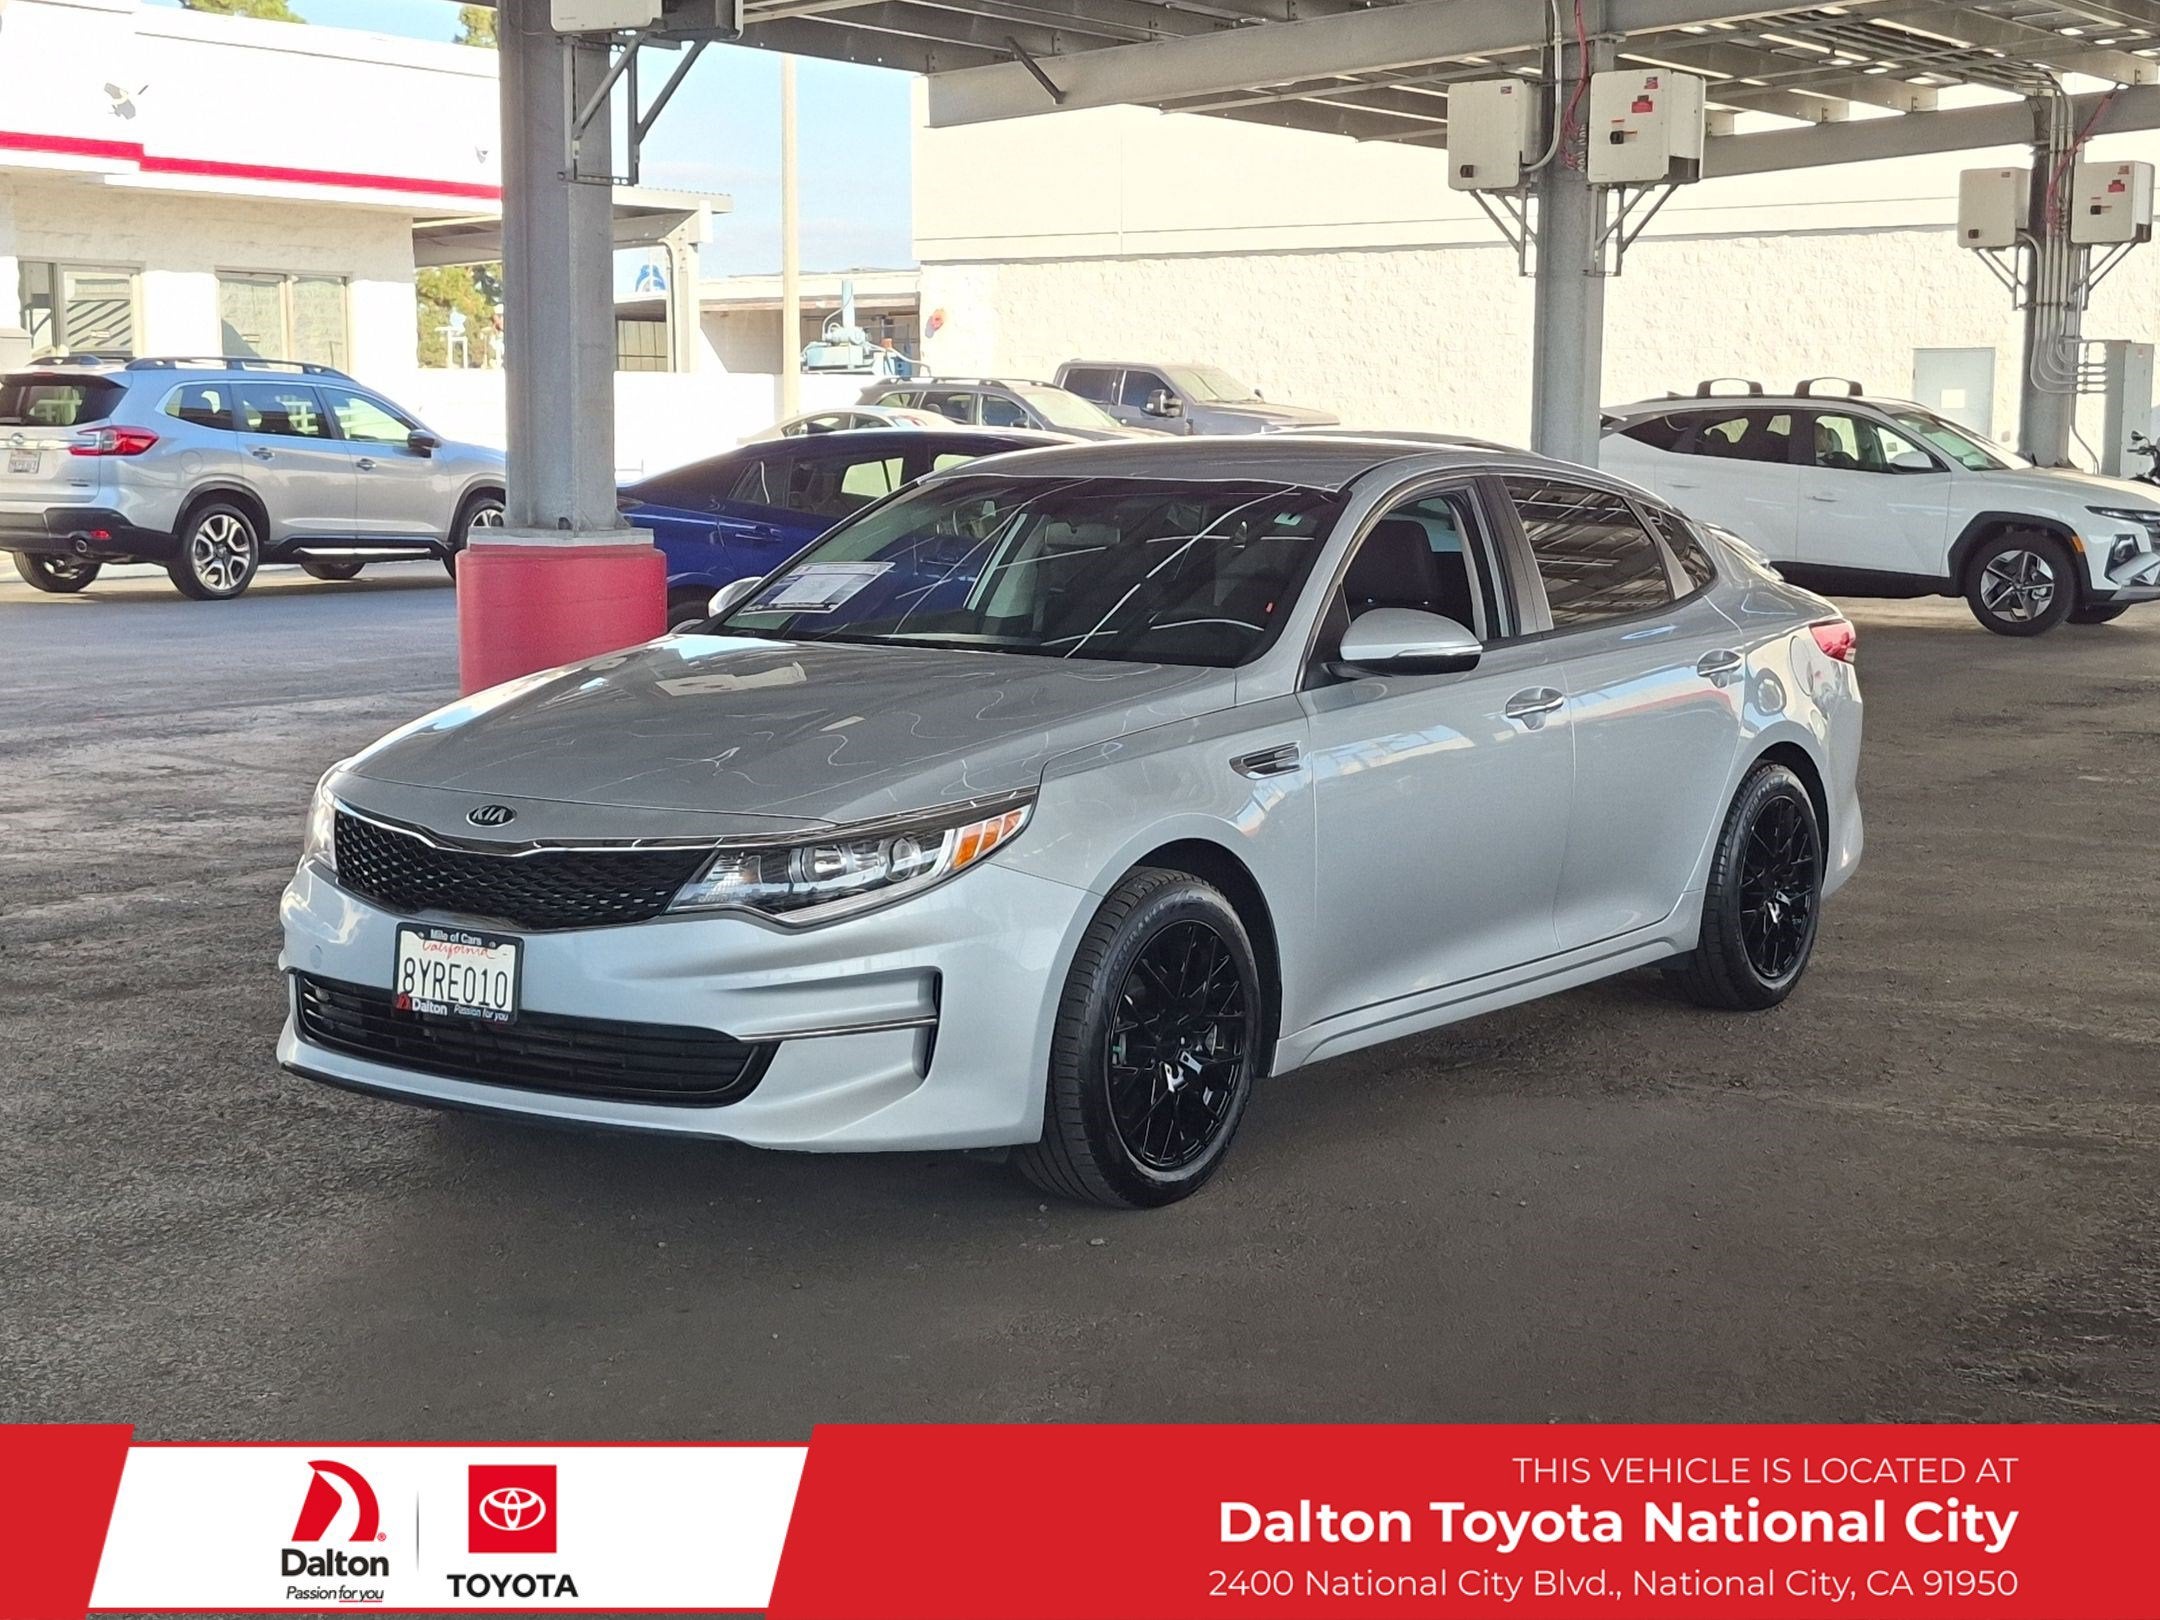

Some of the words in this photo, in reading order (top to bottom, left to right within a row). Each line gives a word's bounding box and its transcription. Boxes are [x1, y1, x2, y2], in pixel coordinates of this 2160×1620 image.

[472, 807, 506, 822] KIA
[430, 929, 448, 940] Mile
[450, 932, 460, 942] of
[460, 934, 482, 946] Cars
[422, 940, 496, 960] California
[402, 957, 508, 1008] 8YRE010
[412, 997, 448, 1015] Dalton
[454, 1003, 481, 1016] Passion
[482, 1007, 494, 1018] for
[494, 1011, 509, 1021] you
